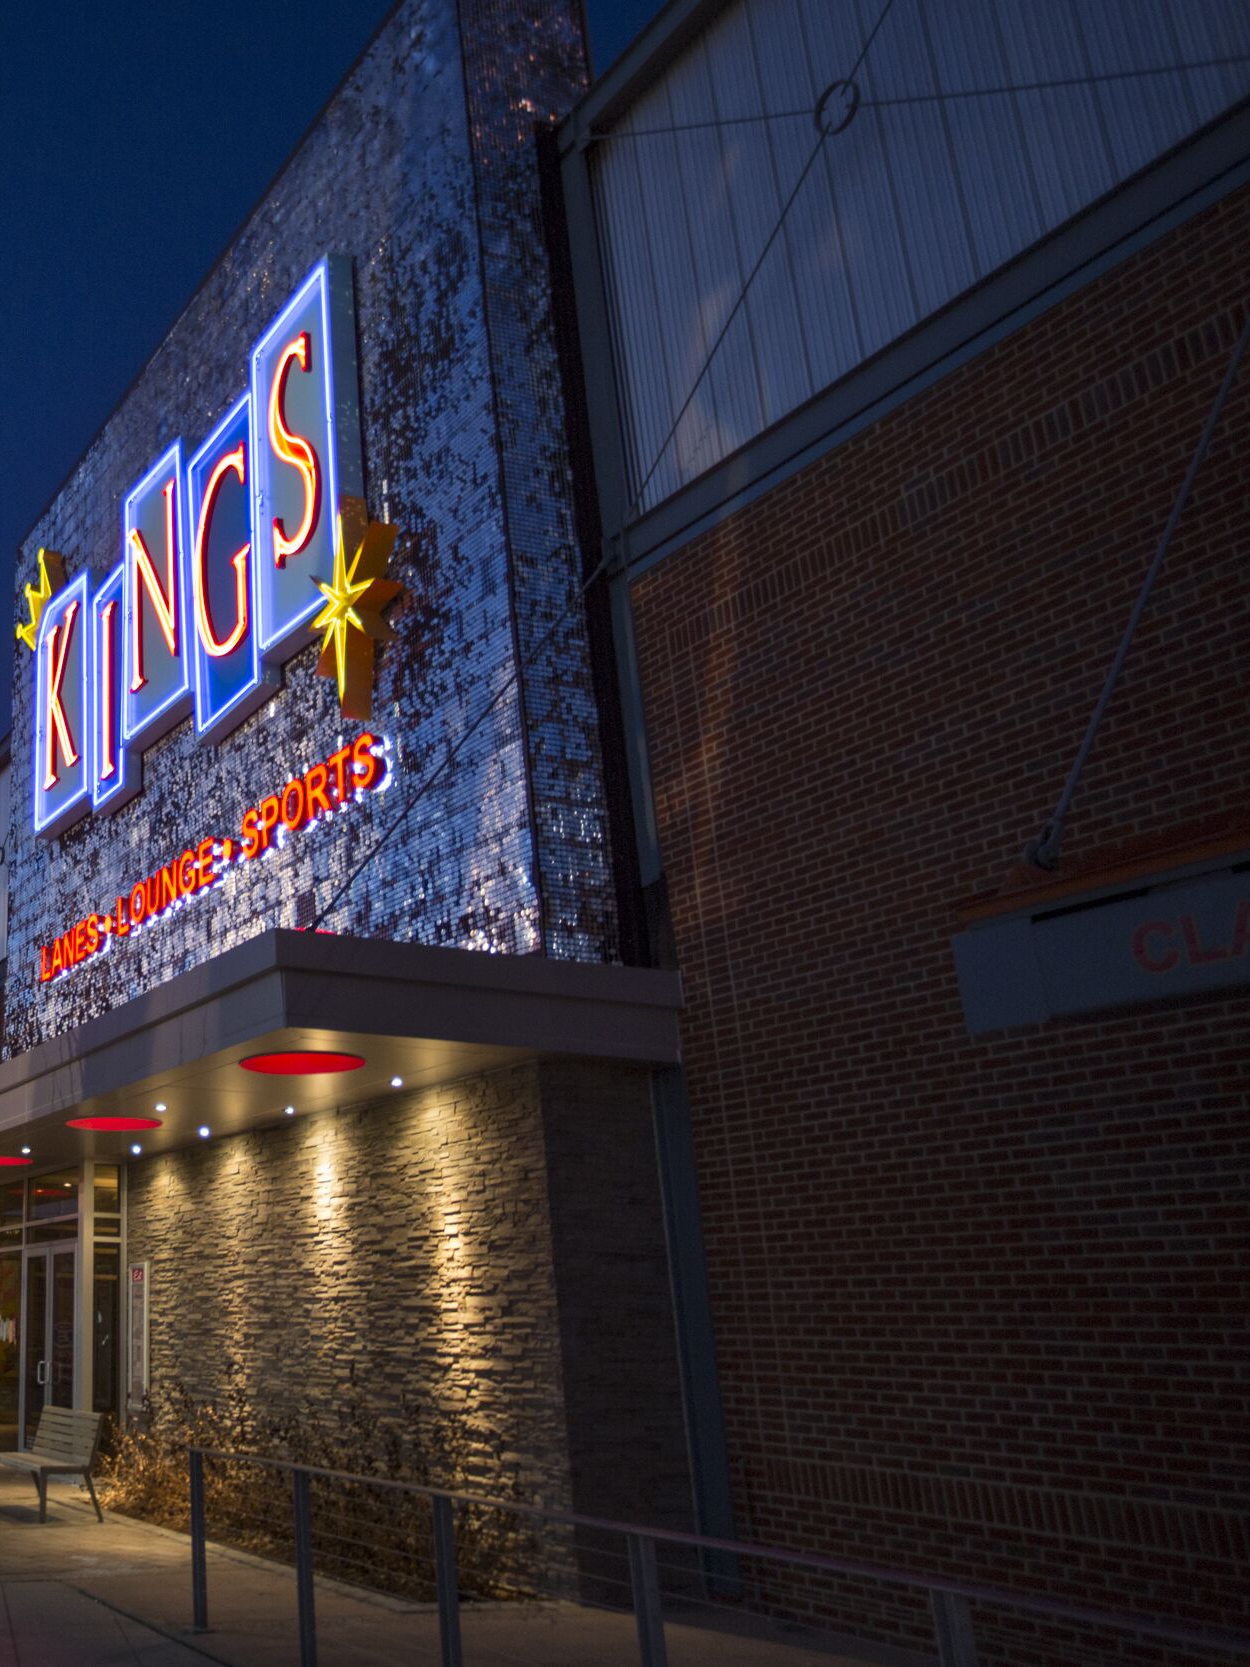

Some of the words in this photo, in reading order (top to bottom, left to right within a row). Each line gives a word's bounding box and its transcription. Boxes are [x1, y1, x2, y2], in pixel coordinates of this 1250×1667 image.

[41, 331, 321, 790] KINGS
[40, 913, 100, 982] LANES
[115, 836, 217, 937] LOUNGE
[241, 731, 386, 860] SPORTS
